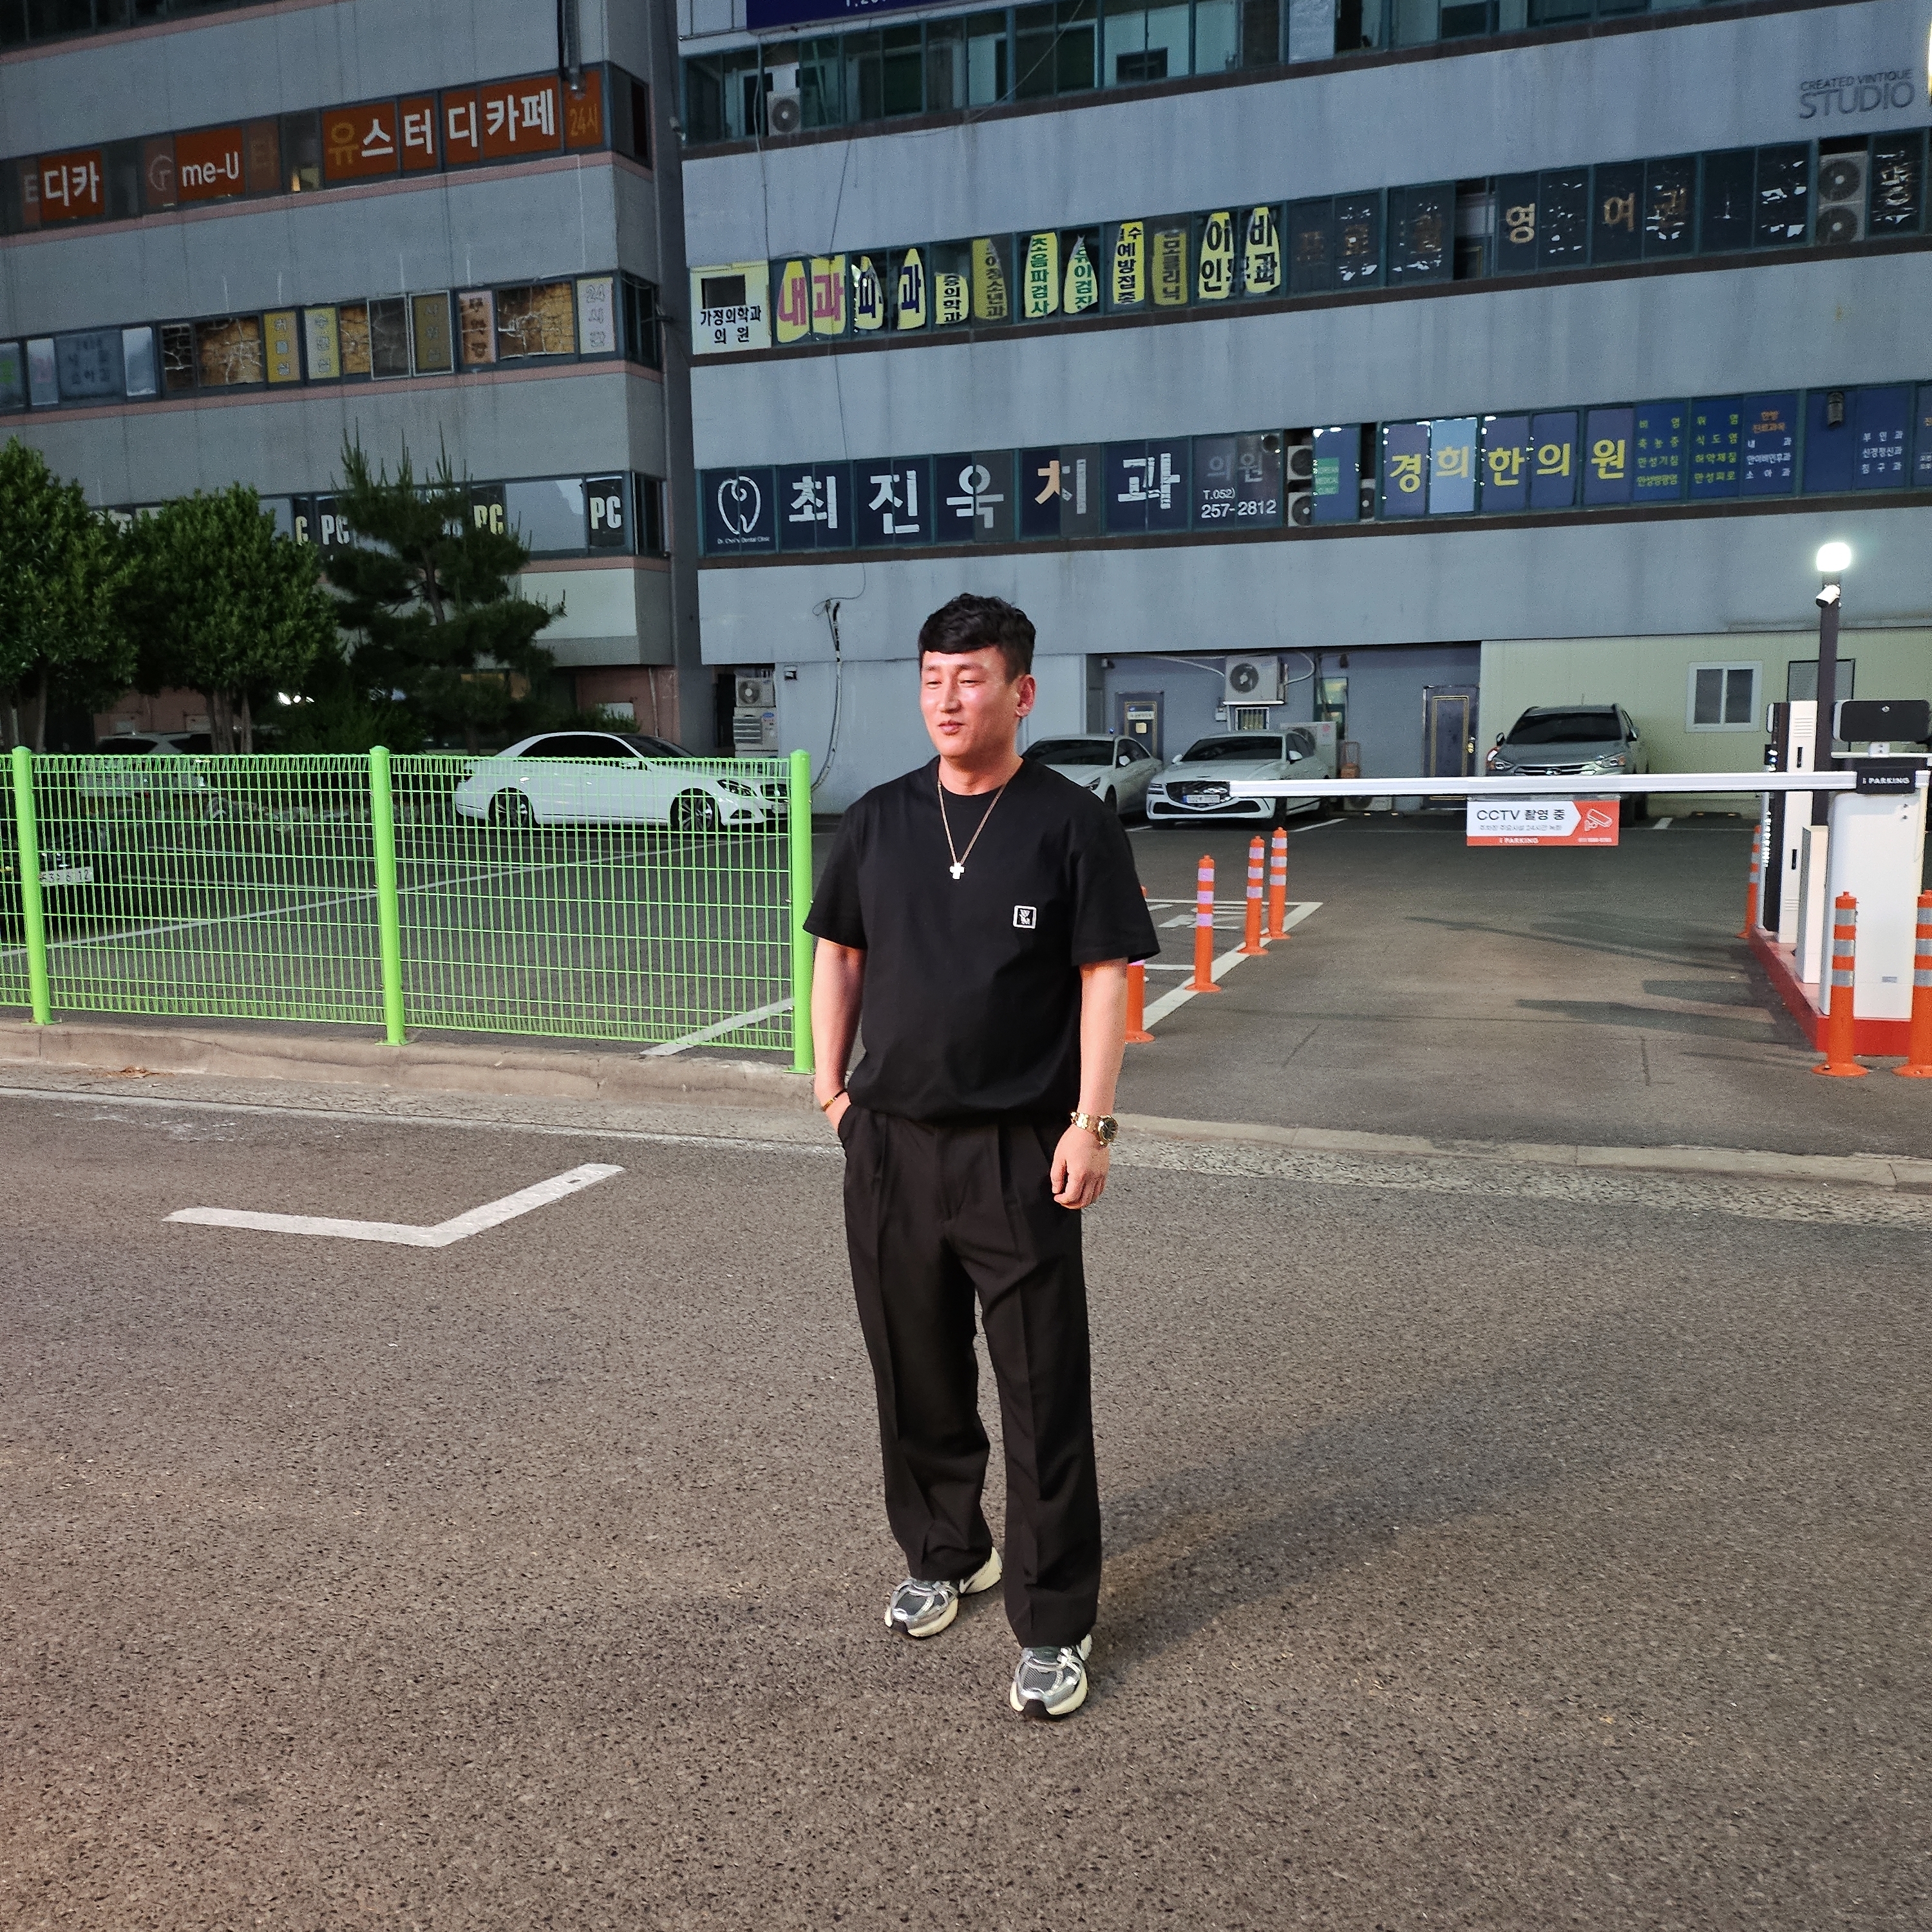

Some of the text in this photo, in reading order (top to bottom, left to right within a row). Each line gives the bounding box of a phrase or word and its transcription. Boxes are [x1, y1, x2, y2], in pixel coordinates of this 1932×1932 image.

[1800, 75, 1855, 91] CREATED
[1799, 80, 1916, 119] STUDIO
[568, 103, 600, 137] 24시
[778, 272, 844, 327] 내과
[699, 305, 762, 327] 가정의학과
[1389, 439, 1626, 493] 경희한의원
[473, 503, 505, 535] PC
[589, 495, 622, 530] PC
[1200, 498, 1278, 519] 257-2812
[320, 514, 350, 546] PC
[1868, 777, 1910, 785] PARKING
[1476, 808, 1566, 821] CCTV 촬영 중
